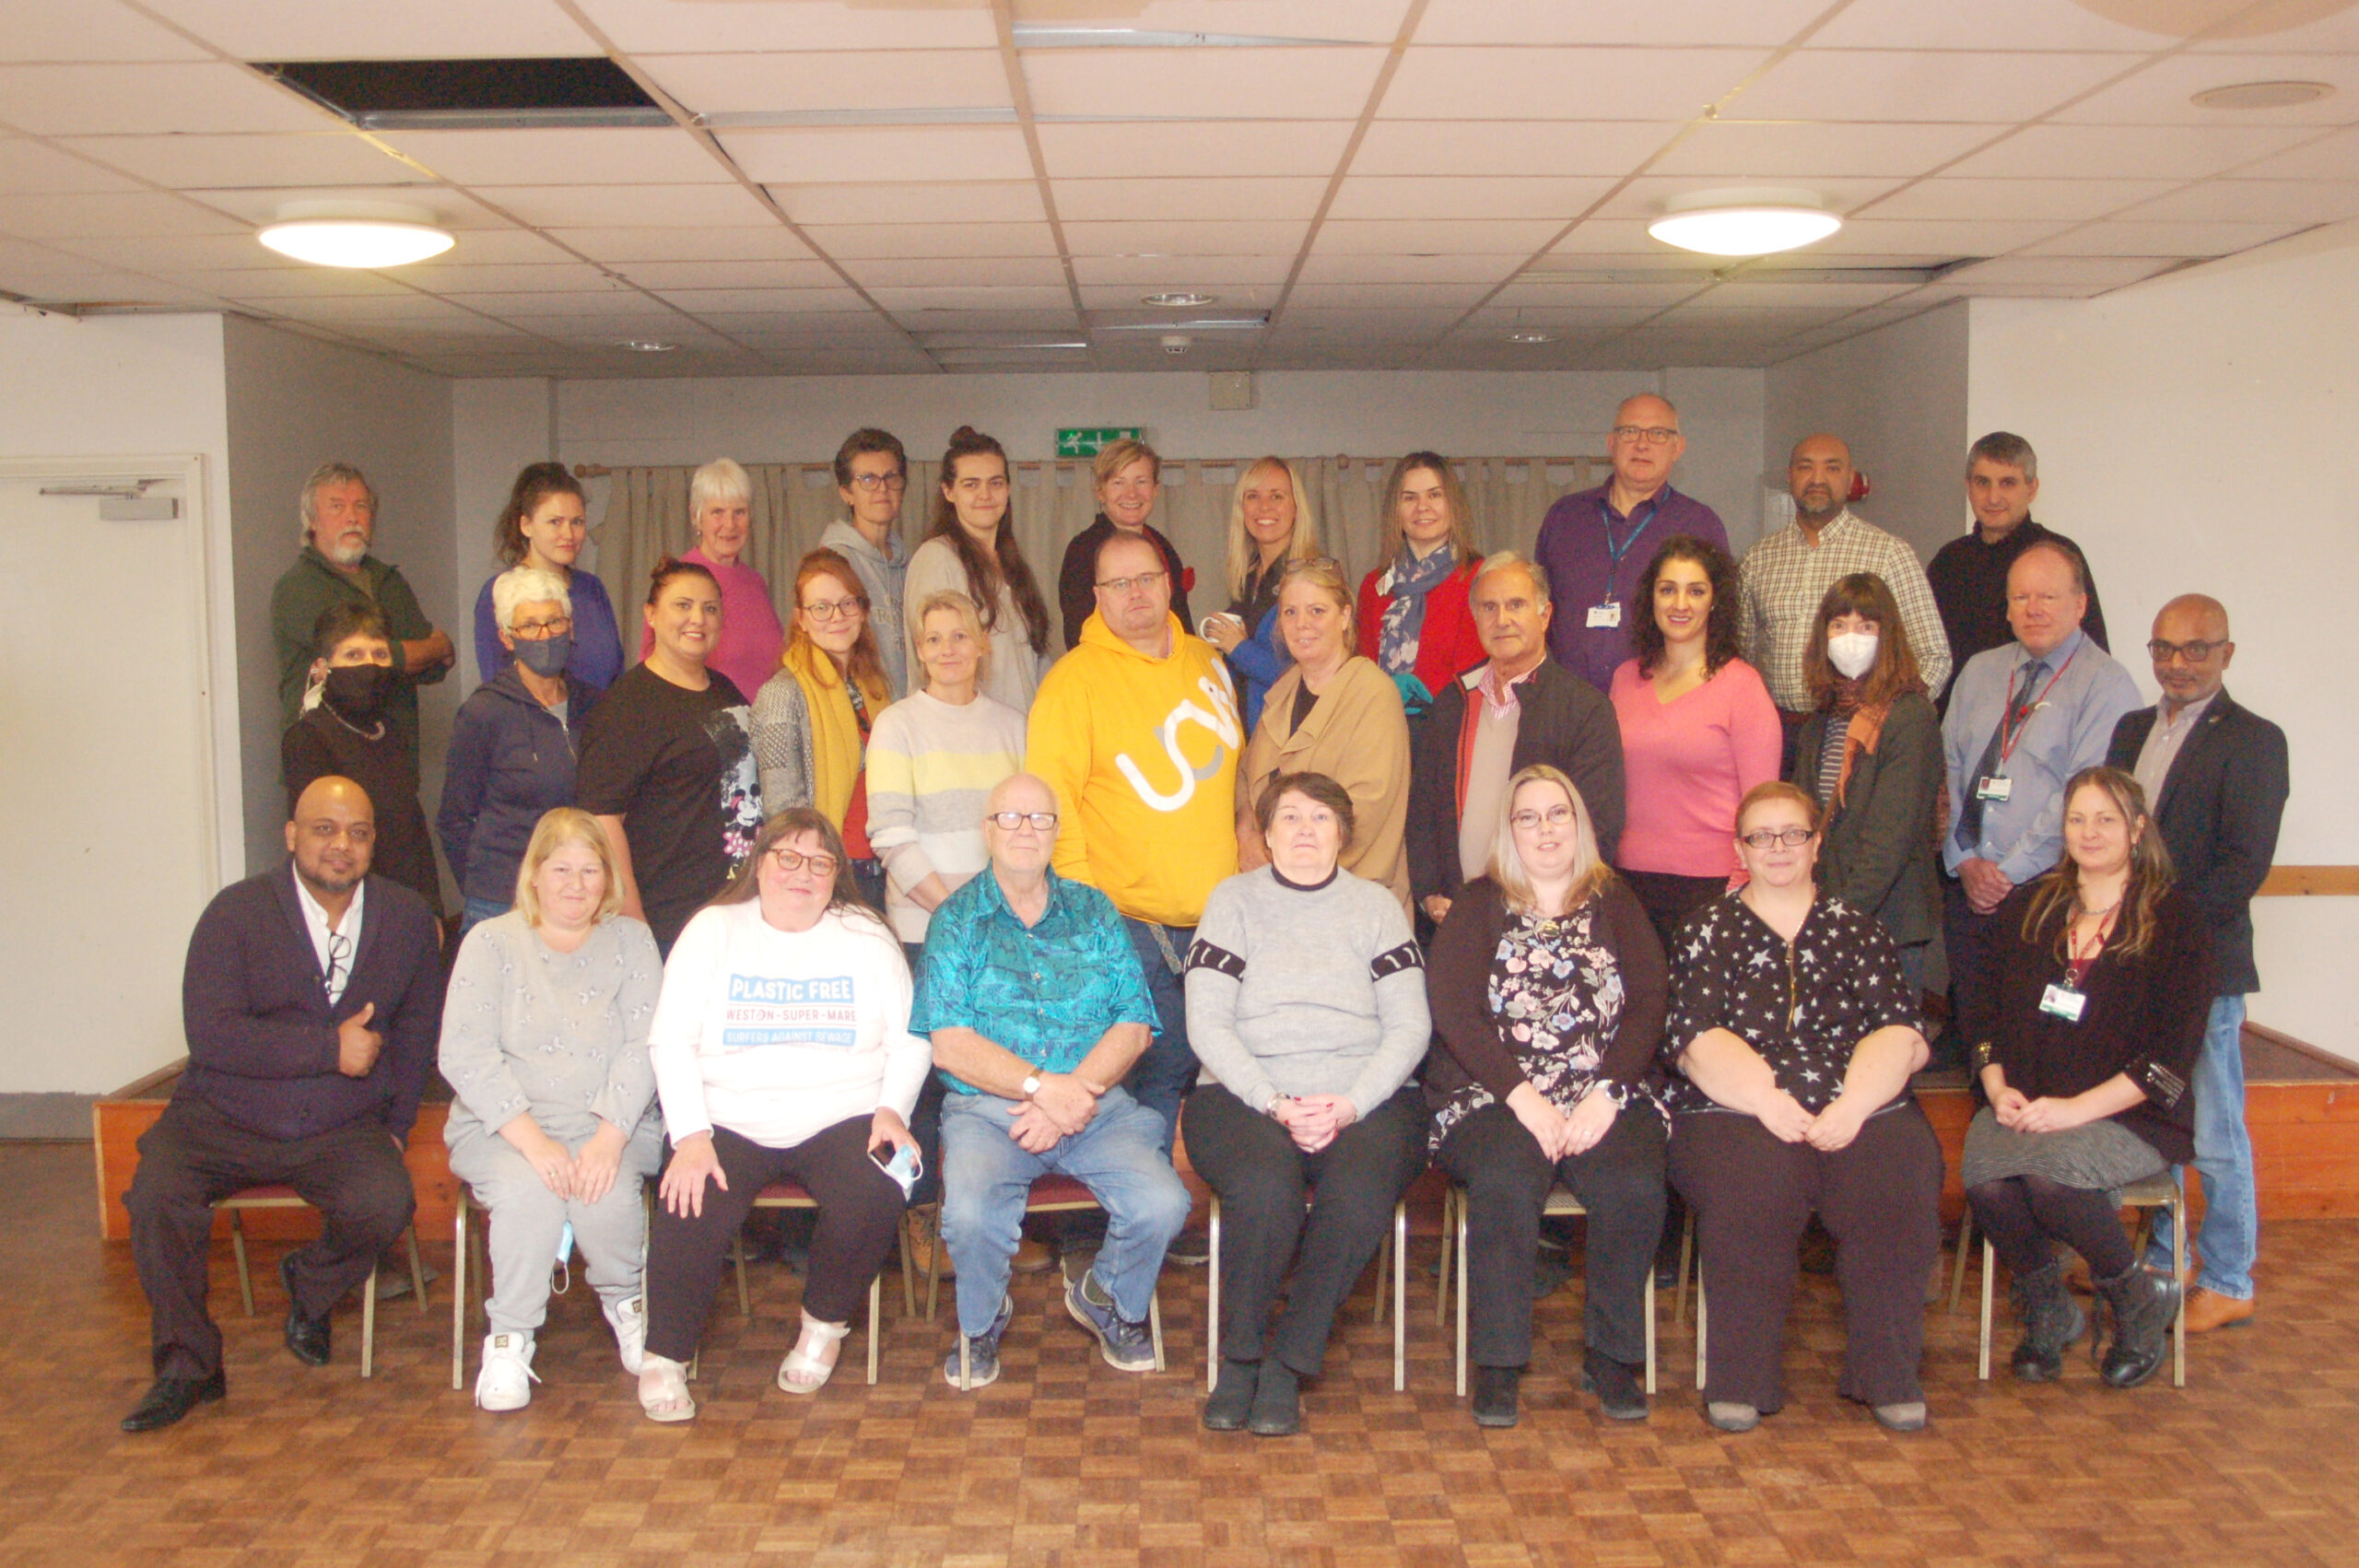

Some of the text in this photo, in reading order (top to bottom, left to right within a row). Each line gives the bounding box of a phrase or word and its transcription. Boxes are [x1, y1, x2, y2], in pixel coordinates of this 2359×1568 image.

[733, 978, 851, 1000] PLASTIC FREE
[726, 1010, 857, 1022] WESTON-SUPER-MARE
[726, 1031, 852, 1043] SURFERS AGAINST SEWAGE
